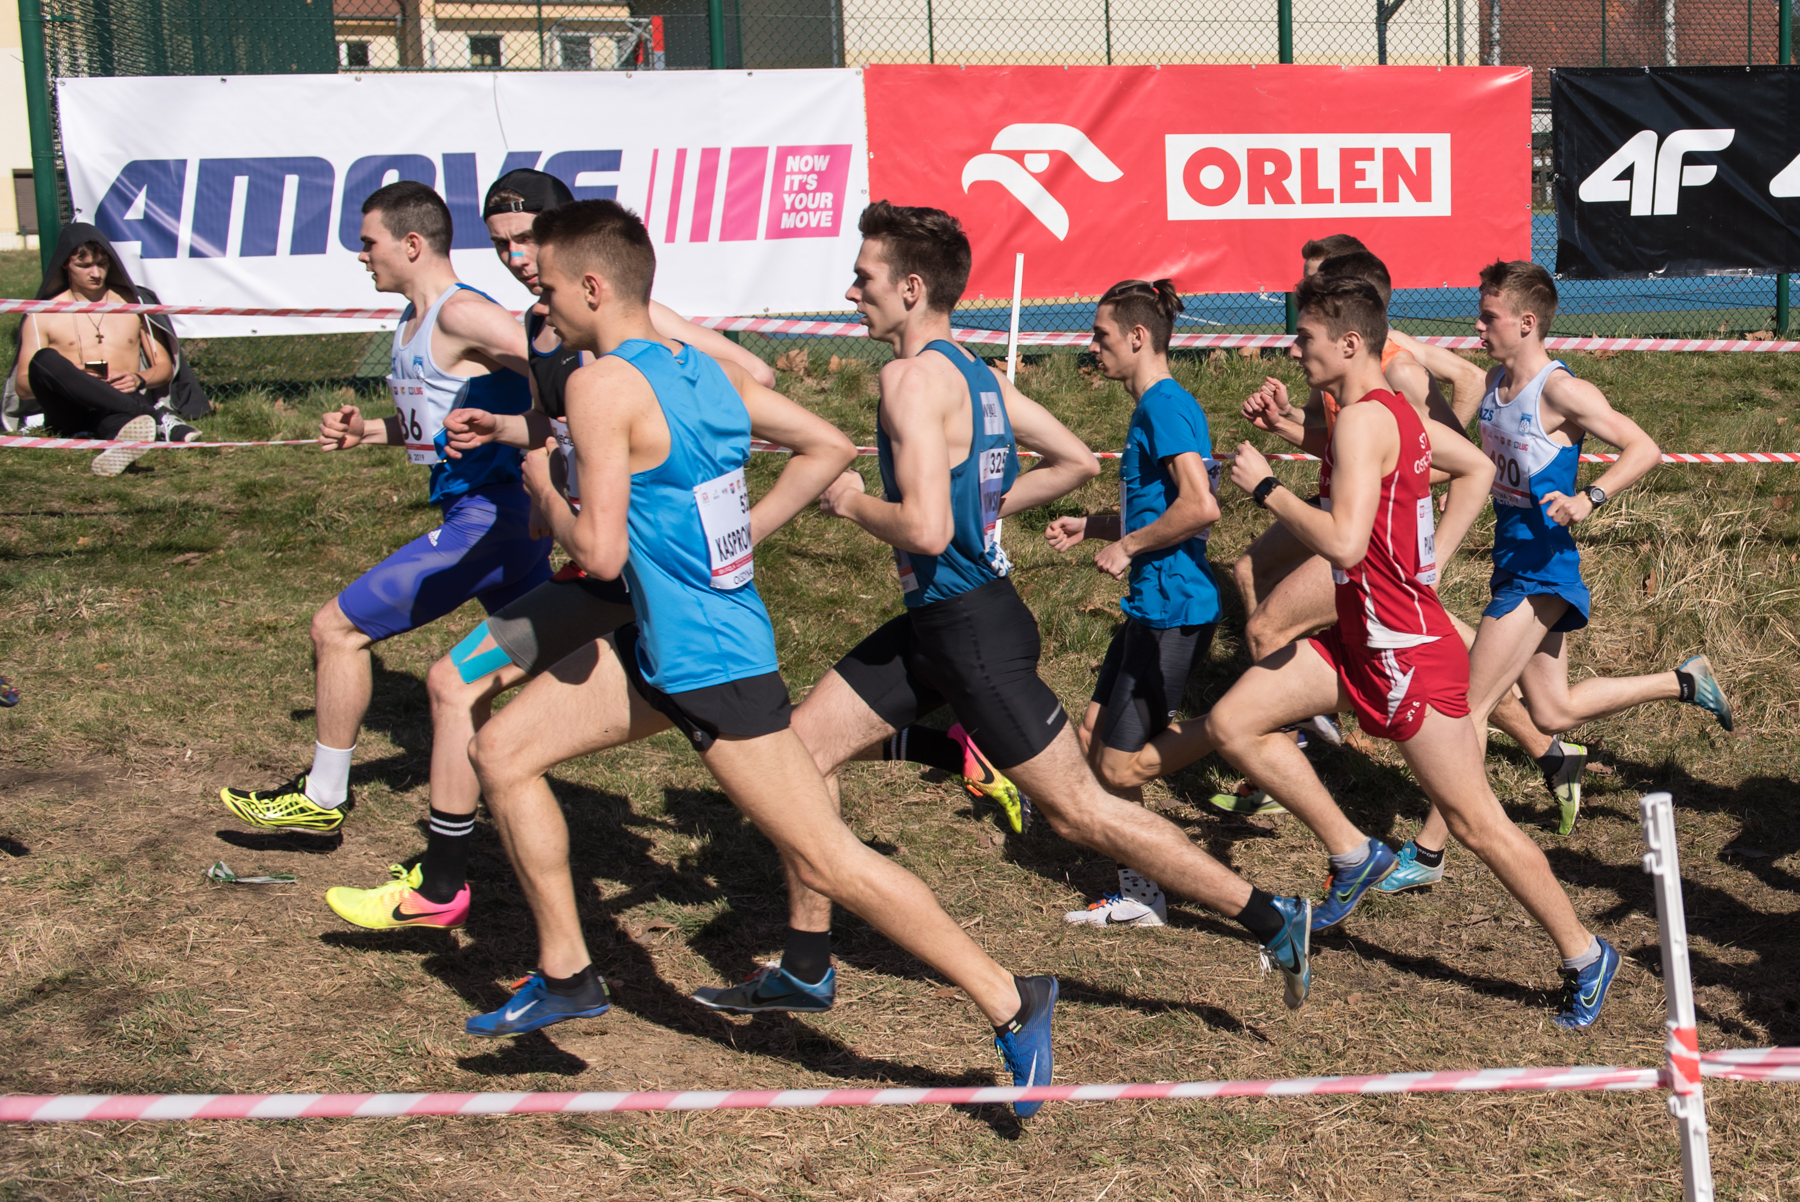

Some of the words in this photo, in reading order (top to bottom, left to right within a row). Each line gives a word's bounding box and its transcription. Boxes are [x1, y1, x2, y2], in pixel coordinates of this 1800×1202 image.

[785, 154, 831, 173] NOW
[1578, 129, 1736, 217] 4F
[783, 173, 819, 192] IT’S
[1182, 145, 1433, 207] ORLEN
[782, 192, 834, 211] YOUR
[780, 210, 834, 230] MOVE
